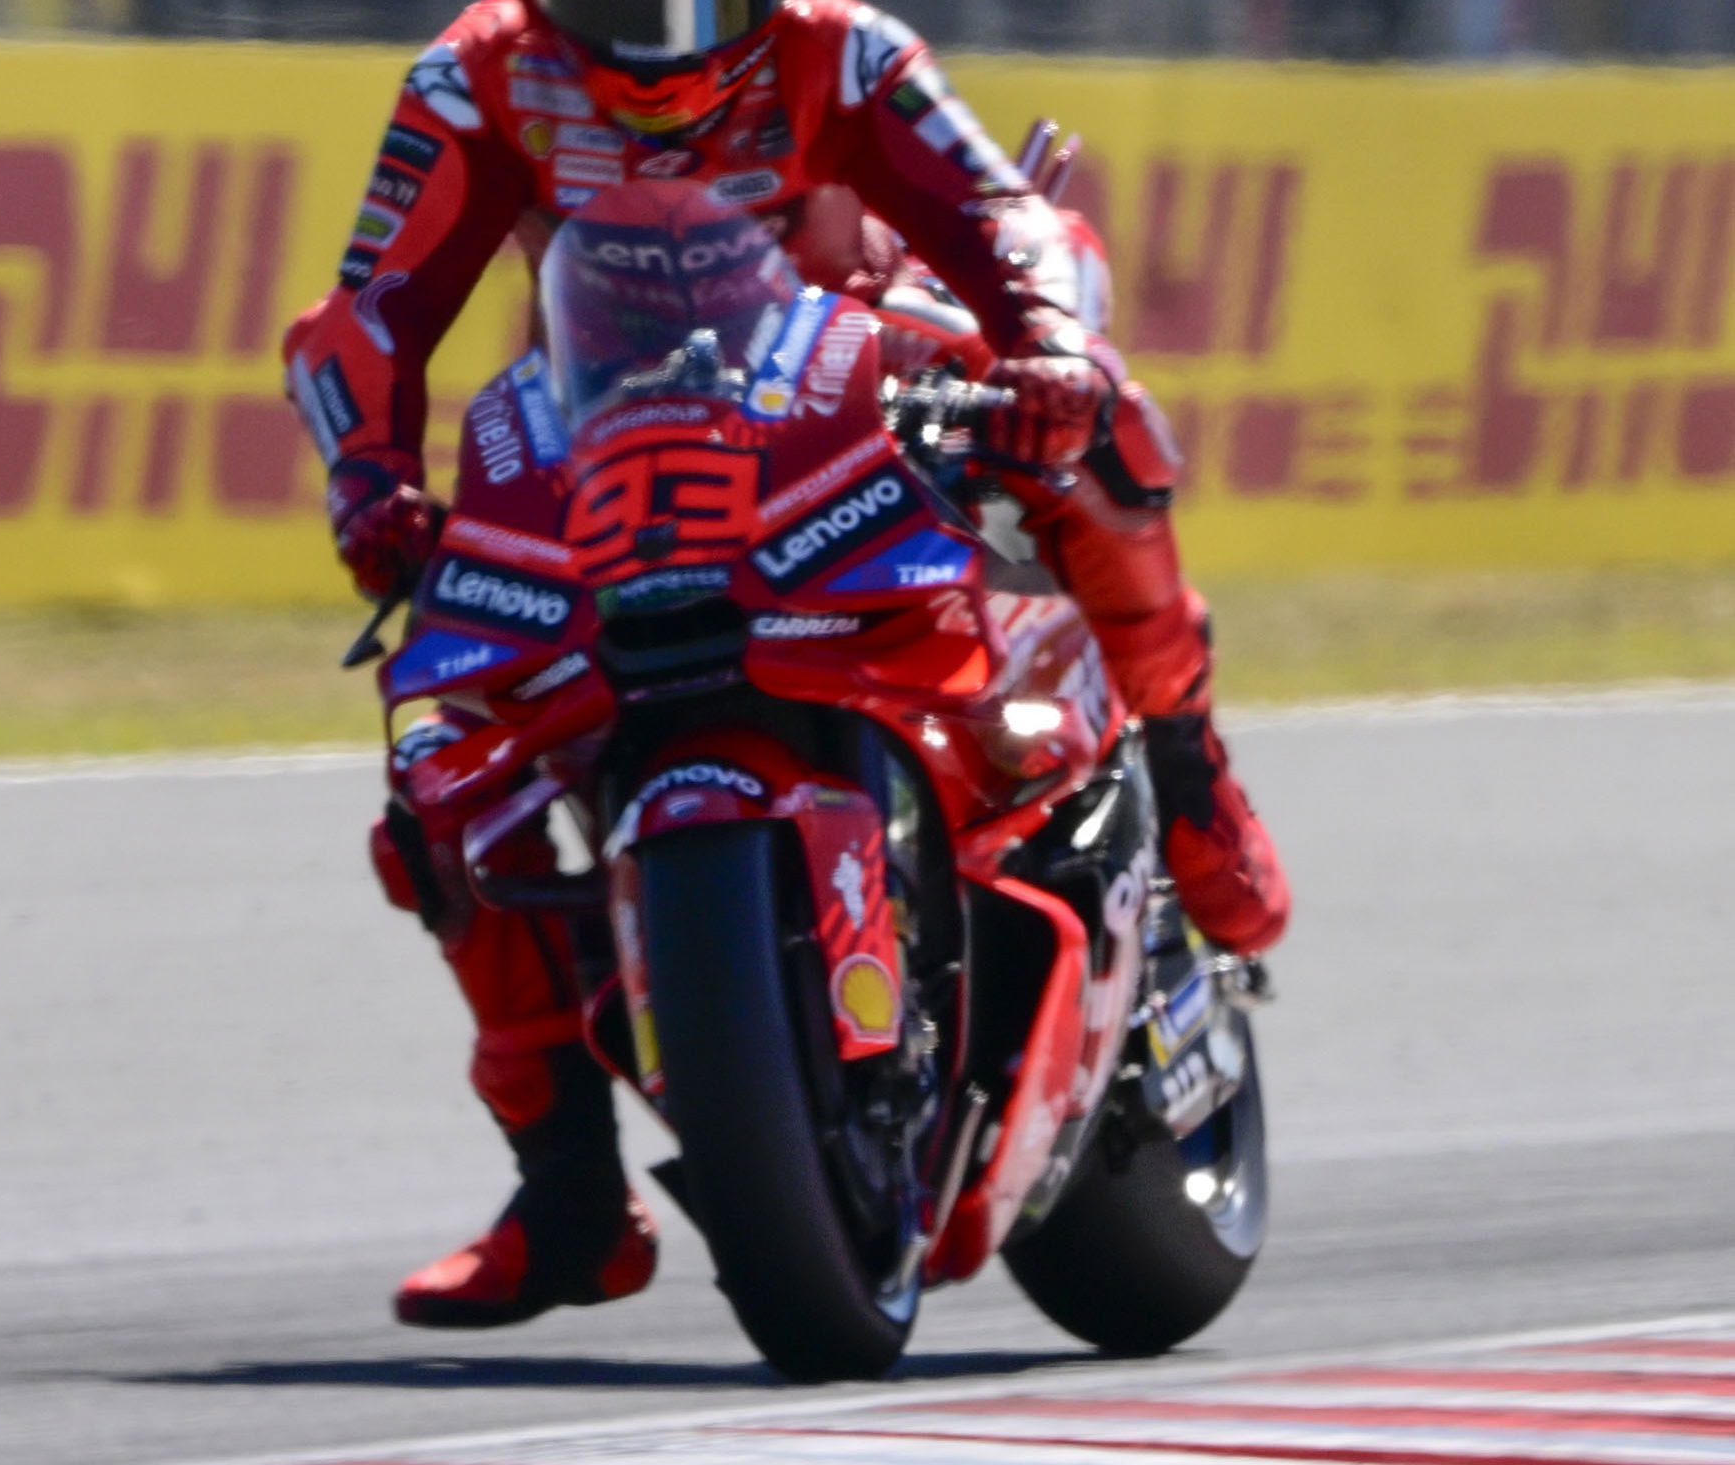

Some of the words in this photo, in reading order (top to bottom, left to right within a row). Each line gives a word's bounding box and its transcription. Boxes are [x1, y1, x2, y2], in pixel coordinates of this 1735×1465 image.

[567, 448, 761, 572] 93
[754, 475, 907, 580] Lenovo
[435, 558, 570, 626] Lenovo
